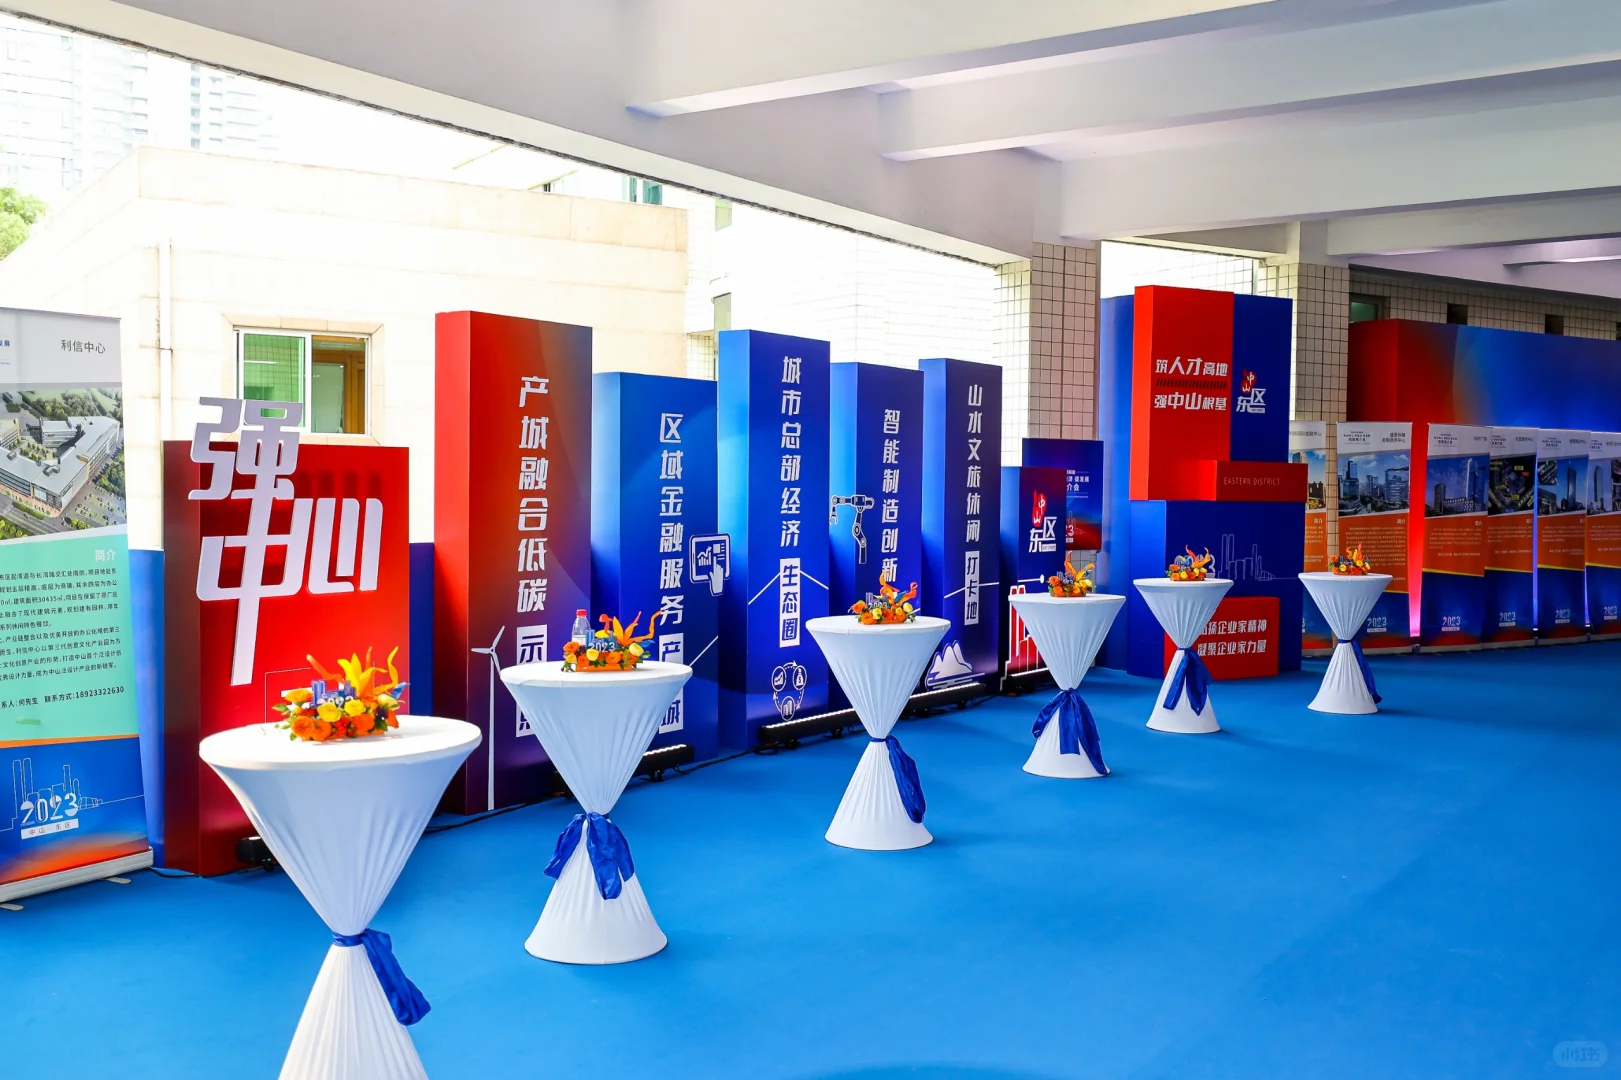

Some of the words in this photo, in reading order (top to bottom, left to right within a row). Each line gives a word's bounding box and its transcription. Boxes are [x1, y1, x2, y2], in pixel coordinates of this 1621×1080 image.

[61, 339, 106, 354] 利信中心
[1155, 356, 1228, 377] 筑人才高地
[1154, 391, 1227, 411] 强中山根基
[1236, 388, 1267, 413] 东区
[780, 356, 801, 547] 城市总部经济
[966, 385, 982, 542] 山水文旅休闲
[518, 376, 549, 612] 产城融合低碳
[882, 409, 900, 582] 智能制造创新
[1223, 476, 1250, 485] EASTERN
[1253, 477, 1280, 486] DISTRICT
[659, 413, 684, 626] 区域金融服务
[1028, 516, 1058, 553] 东区
[95, 549, 116, 562] 简介
[781, 564, 799, 641] 生态圈
[965, 554, 978, 621] 打卡地
[1197, 639, 1267, 656] 凝聚企业家力量
[20, 792, 79, 826] 2023
